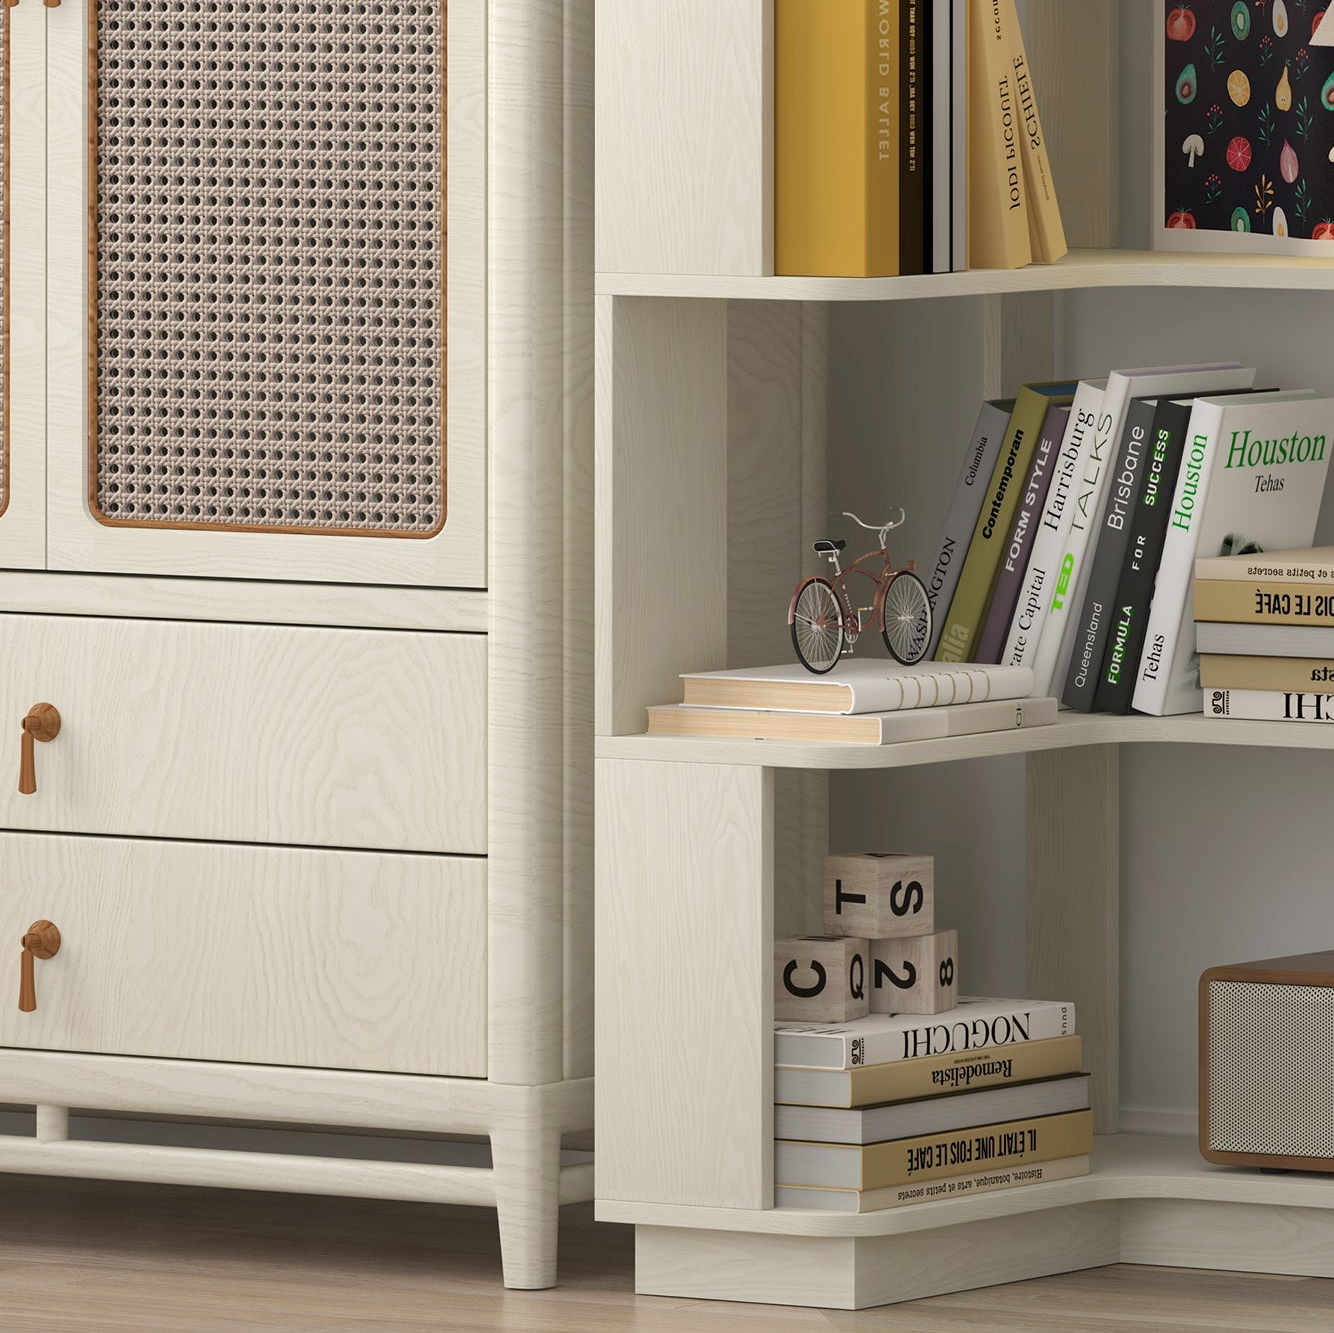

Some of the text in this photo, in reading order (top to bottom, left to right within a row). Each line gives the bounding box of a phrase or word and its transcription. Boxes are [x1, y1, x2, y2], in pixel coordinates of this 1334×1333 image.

[965, 436, 988, 486] Columbia
[1044, 408, 1095, 531] Harrisburg
[1224, 430, 1326, 469] Houston
[982, 429, 1024, 540] Contemporan
[1108, 426, 1145, 531] Brisbane
[1172, 434, 1208, 533] Houston
[1254, 474, 1285, 493] Tehas
[1005, 438, 1052, 572] FORM STYLE
[1050, 412, 1112, 613] TED TALKS
[1108, 429, 1169, 685] FORMULA FOR SUCCESS
[906, 537, 956, 661] WASHNGTON
[1019, 567, 1046, 631] Capital
[1075, 602, 1103, 688] Queensland
[1143, 634, 1165, 682] Tehas
[835, 879, 866, 915] T
[890, 880, 923, 916] S
[783, 959, 827, 998] C
[850, 954, 864, 1000] Q
[874, 958, 917, 989] 2
[939, 957, 954, 987] 8
[902, 1013, 1031, 1059] NOGUCHI
[932, 1059, 1013, 1087] Remodelista
[907, 1129, 1037, 1176] IL ÉTAIT UNE FOIS LE CAFÉ
[898, 1168, 1043, 1200] Histoire, botanique, arts et petits secrets
